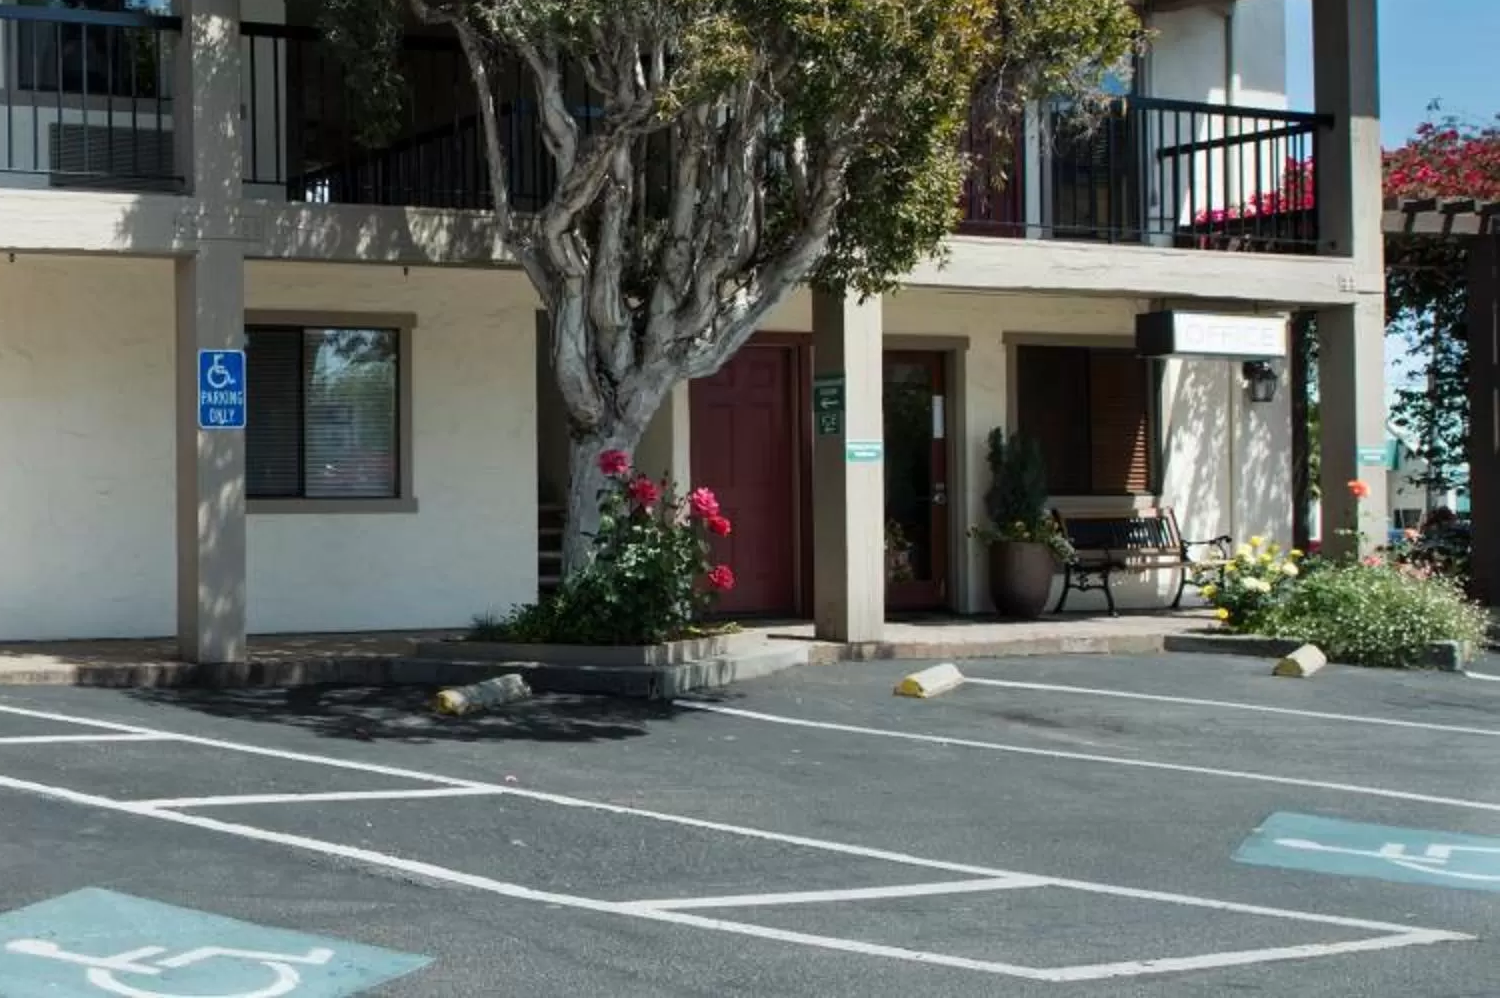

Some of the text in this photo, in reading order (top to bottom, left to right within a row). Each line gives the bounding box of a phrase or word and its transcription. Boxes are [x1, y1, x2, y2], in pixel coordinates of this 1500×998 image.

[1185, 324, 1275, 347] OFFICE
[201, 390, 243, 405] PARKING
[209, 408, 235, 423] ONLY
